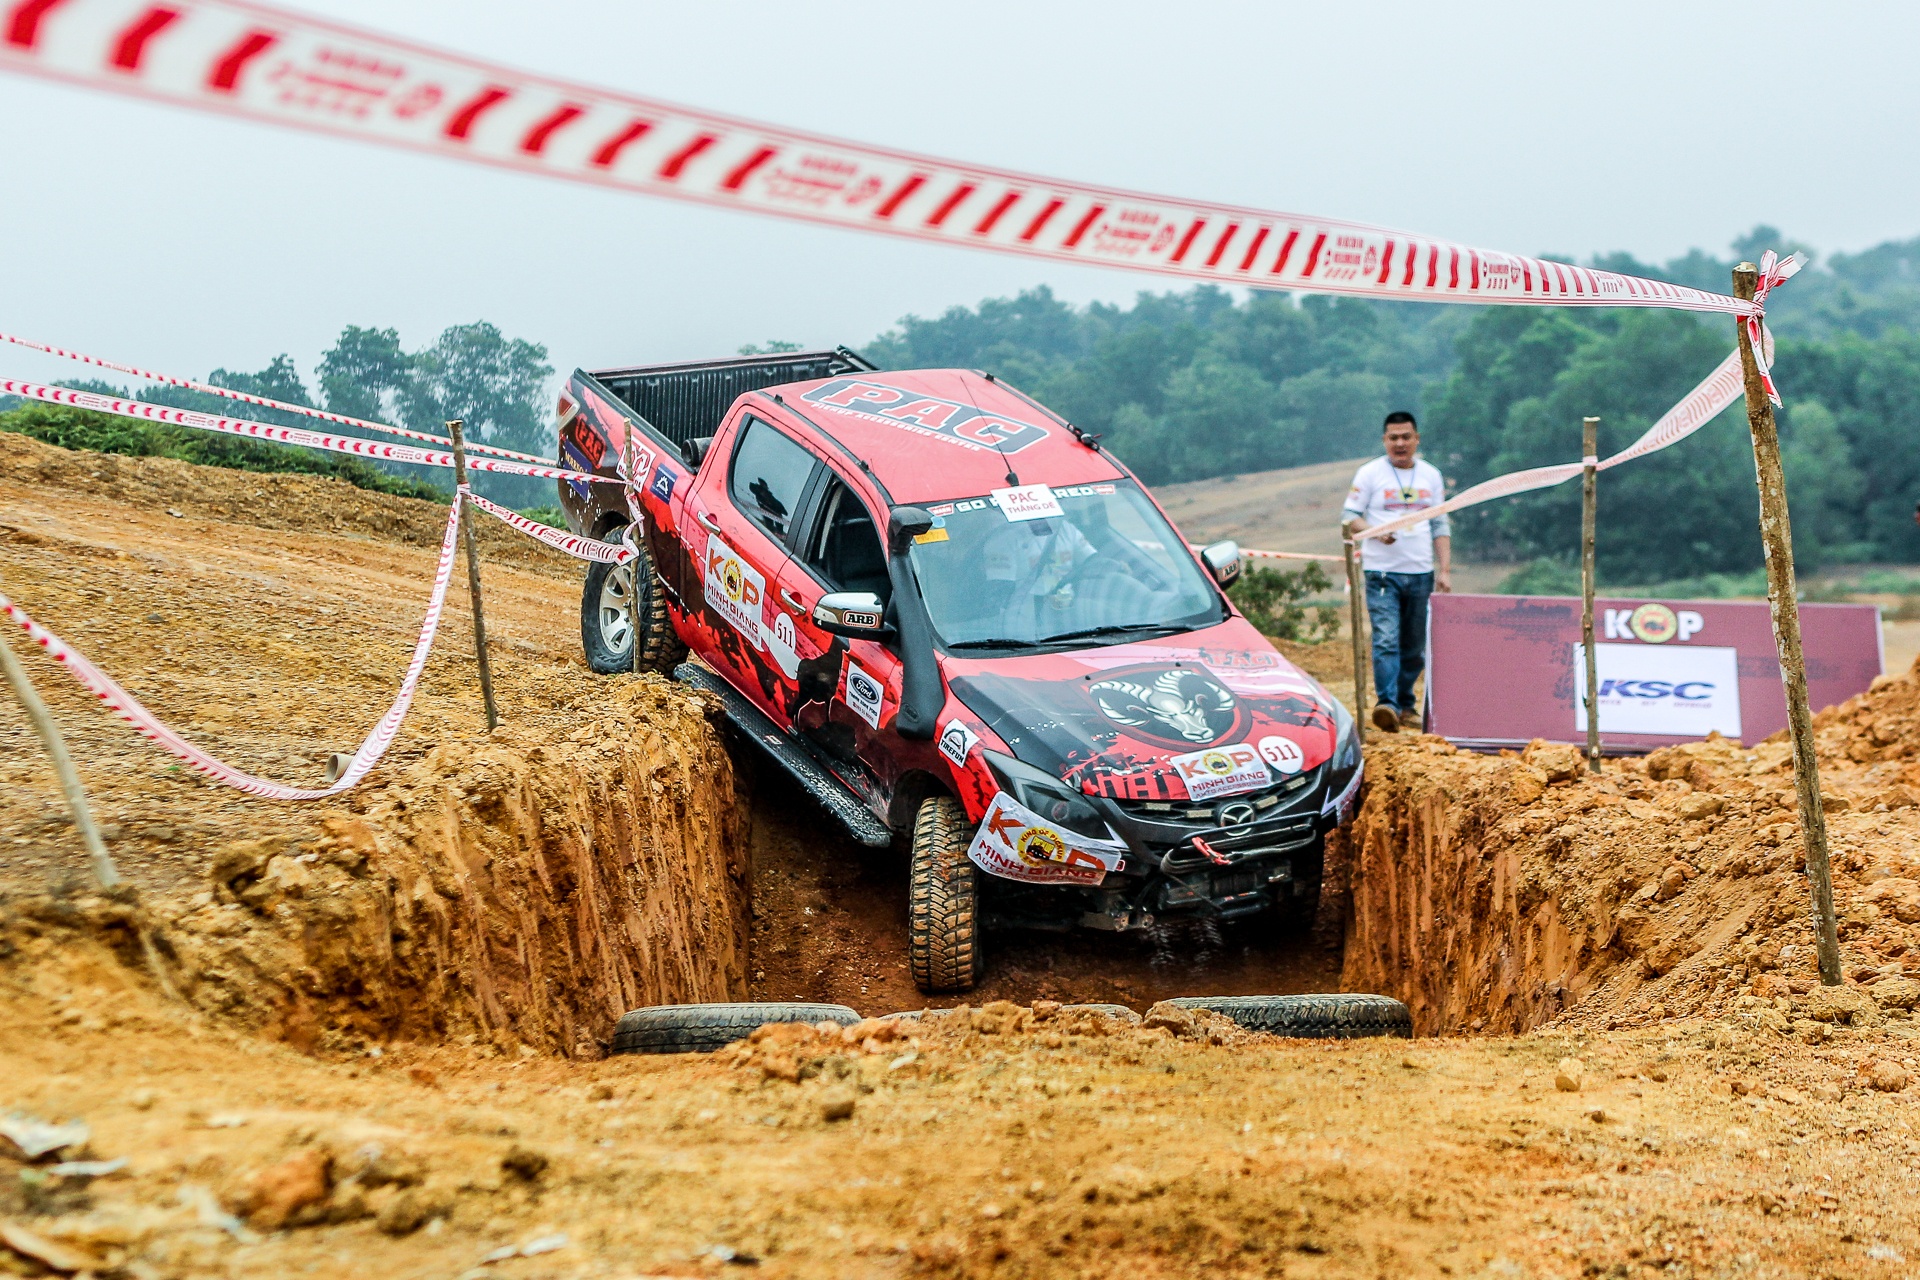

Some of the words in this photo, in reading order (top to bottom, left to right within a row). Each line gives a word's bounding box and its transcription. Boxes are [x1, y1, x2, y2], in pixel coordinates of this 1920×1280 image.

[818, 382, 1028, 447] PAC
[955, 499, 987, 513] GO
[1008, 490, 1039, 504] PAC
[707, 581, 729, 610] MINH
[729, 603, 759, 635] GIANG
[847, 612, 875, 626] ARB
[777, 621, 793, 649] 511
[855, 680, 874, 700] Ford
[1598, 679, 1717, 700] KSC
[940, 739, 965, 764] TIREFUN
[1264, 744, 1299, 762] 511
[1191, 780, 1224, 792] MINH
[1225, 771, 1265, 784] GIANG
[1020, 829, 1037, 843] KING
[1049, 833, 1063, 860] PICKUP
[974, 852, 1004, 875] AUTO
[978, 839, 1024, 872] MINH
[1028, 866, 1098, 880] GIANG
